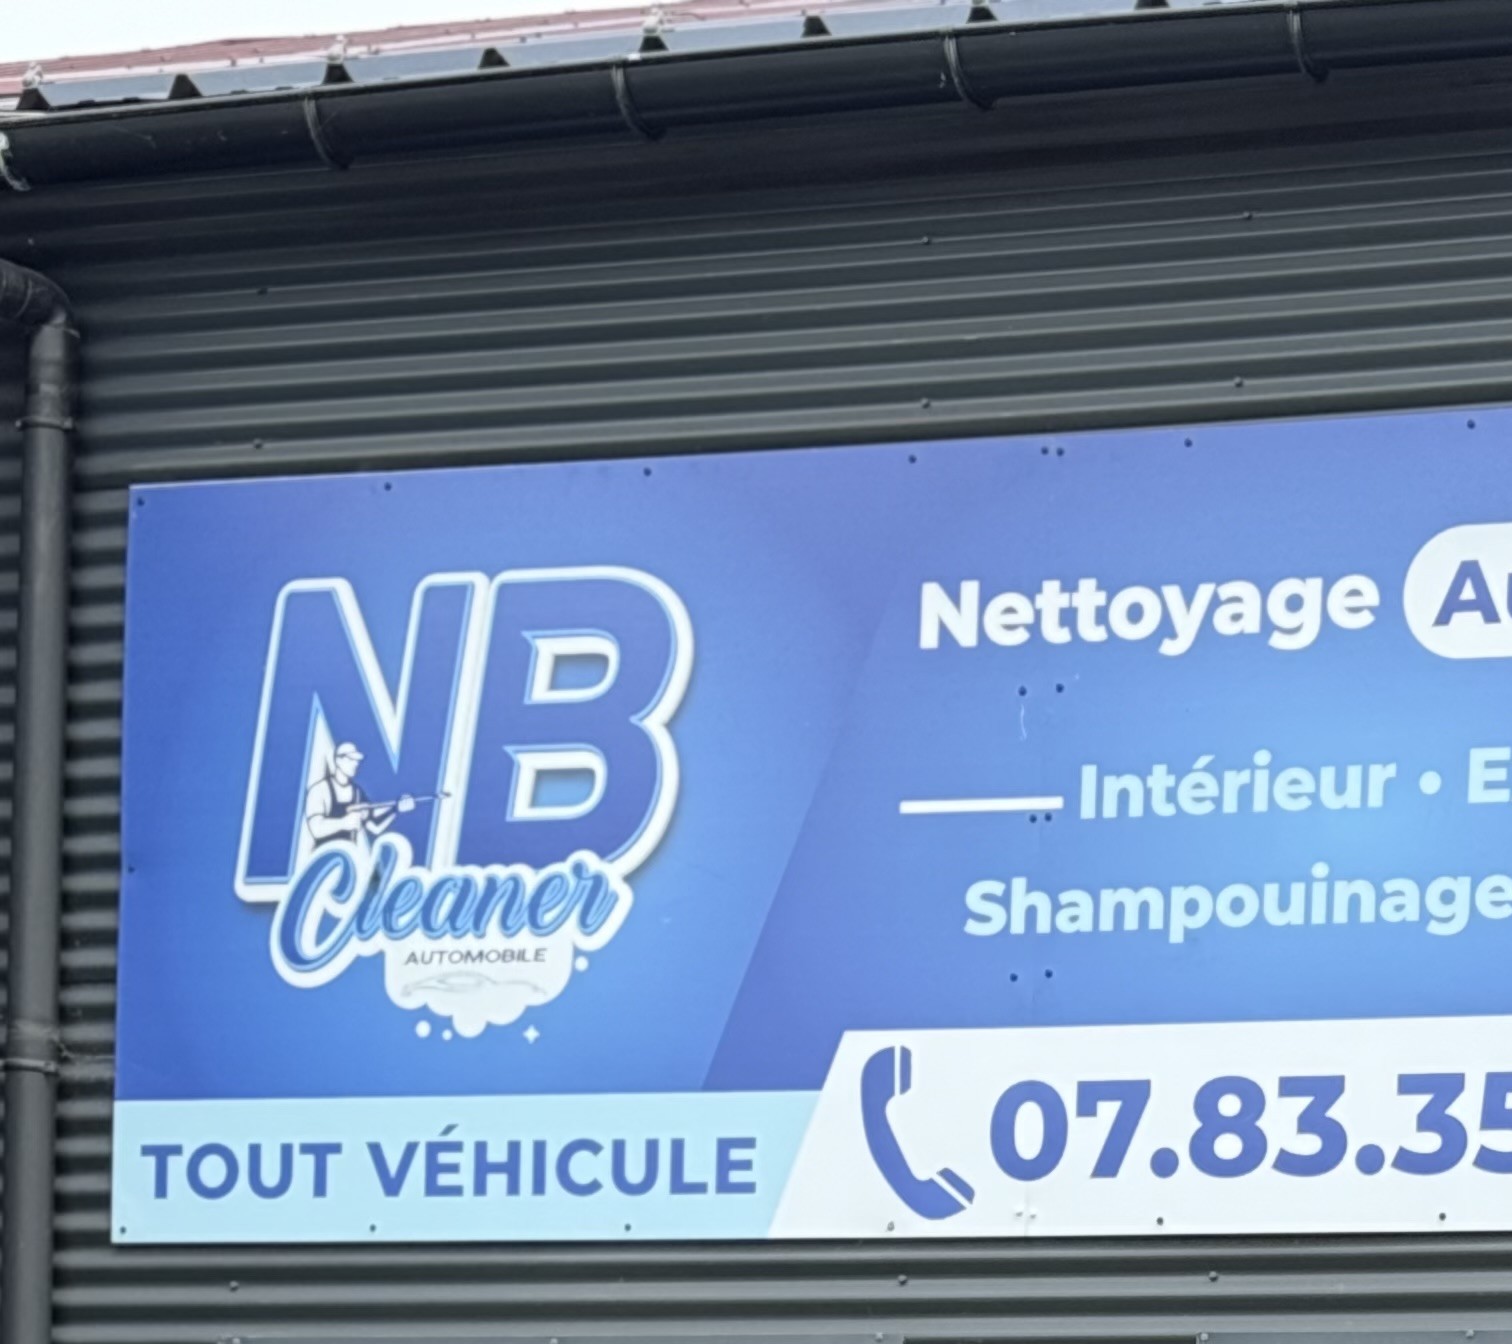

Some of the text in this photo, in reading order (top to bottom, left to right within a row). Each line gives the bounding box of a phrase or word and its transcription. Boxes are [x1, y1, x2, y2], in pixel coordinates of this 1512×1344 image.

[918, 573, 1381, 657] Nettoyage
[234, 565, 694, 903] NB
[1080, 749, 1397, 820] Intérieur
[274, 838, 625, 978] Cleaner
[404, 947, 548, 966] AUTOMOBILE
[140, 1123, 758, 1199] TOUT VÉHICULE
